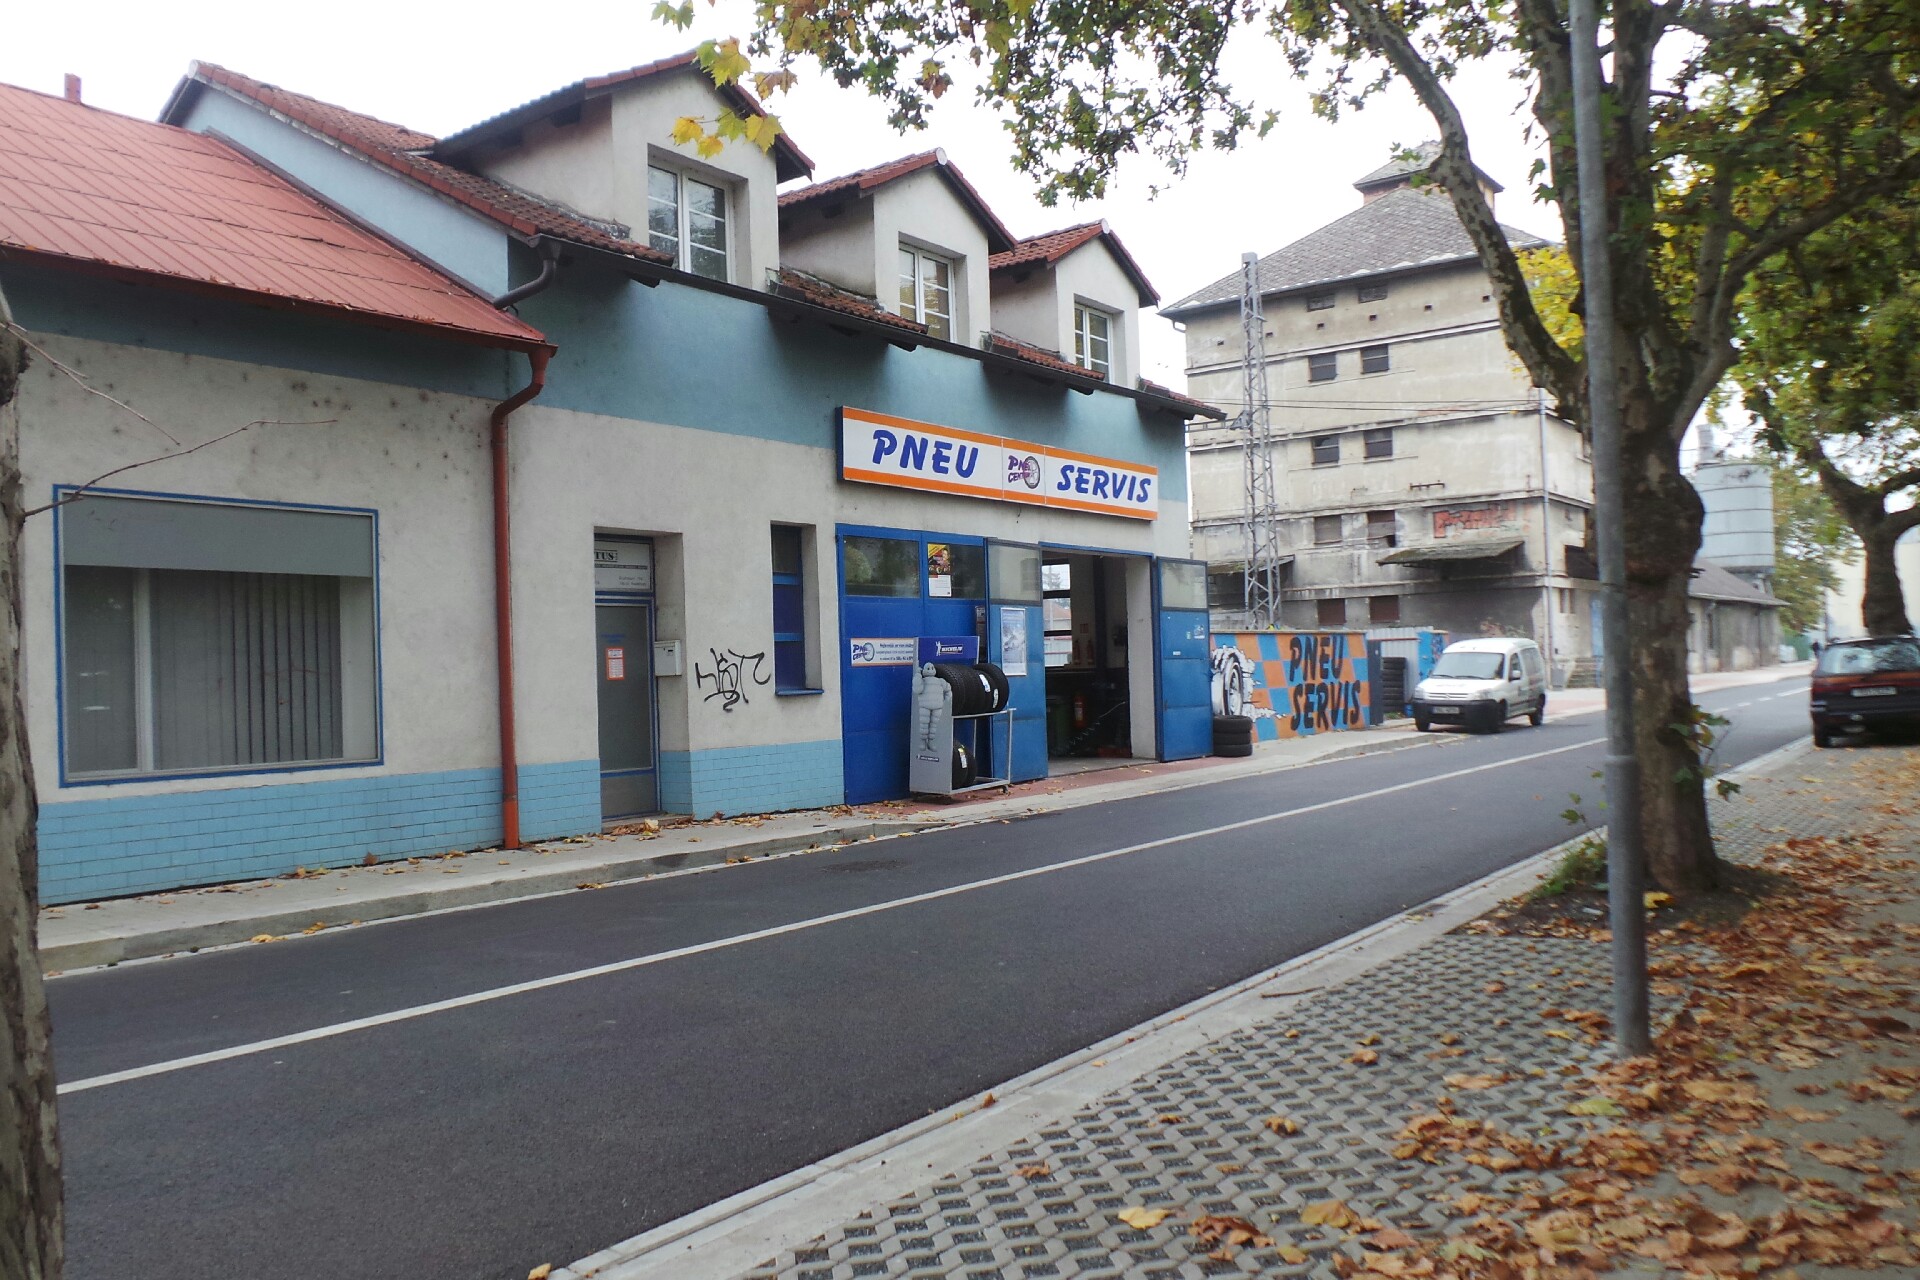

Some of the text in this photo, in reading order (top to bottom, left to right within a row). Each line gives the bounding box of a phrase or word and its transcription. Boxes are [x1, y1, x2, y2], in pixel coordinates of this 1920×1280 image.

[872, 429, 1151, 503] PNEU SERVIS
[1289, 635, 1344, 683] PNEU
[1291, 680, 1361, 731] SERVIS
